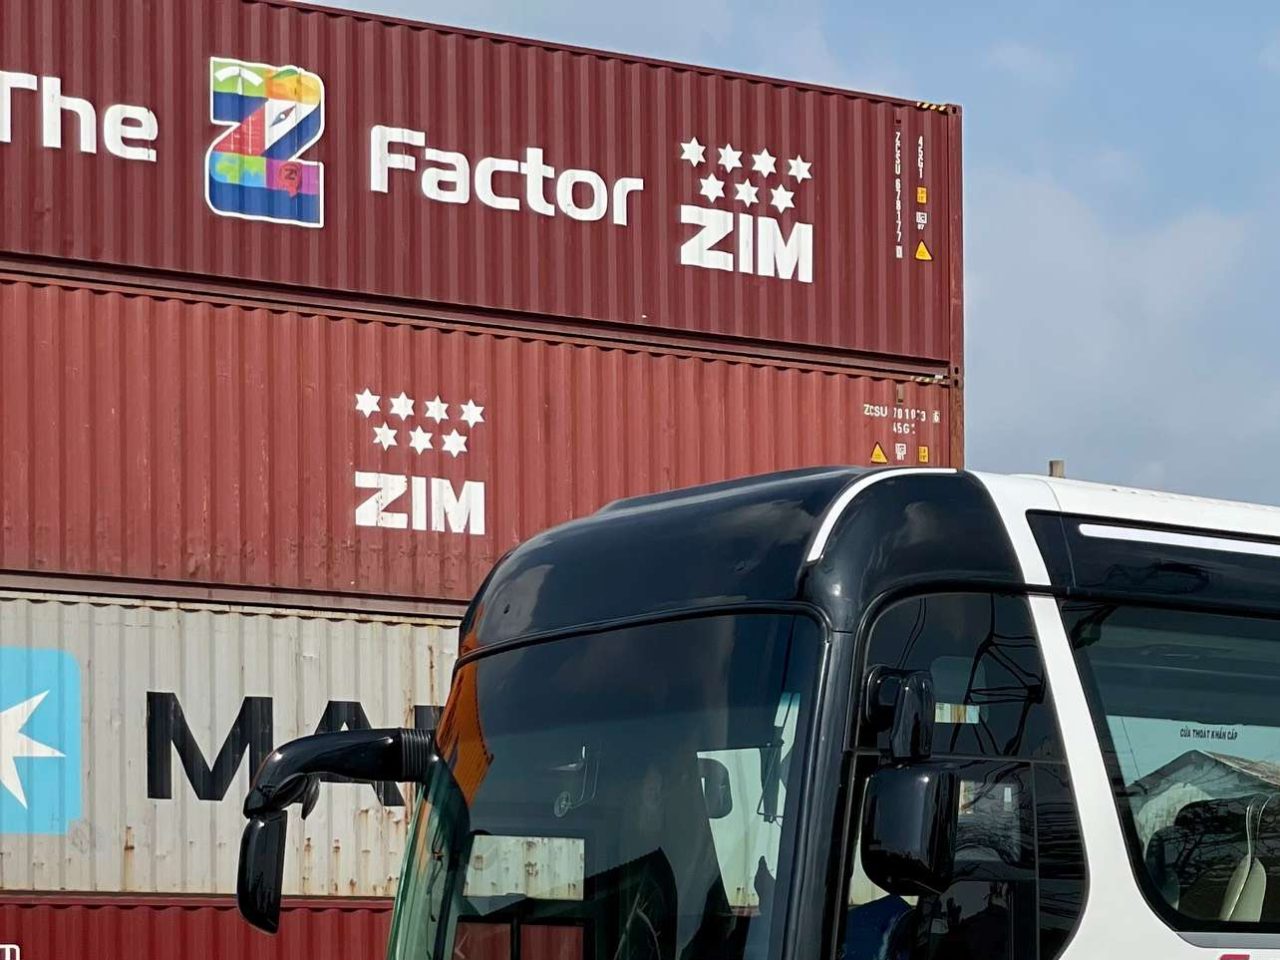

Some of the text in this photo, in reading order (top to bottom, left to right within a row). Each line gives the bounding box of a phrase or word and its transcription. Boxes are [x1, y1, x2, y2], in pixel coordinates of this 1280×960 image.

[0, 70, 158, 162] The
[370, 125, 644, 226] Factor
[680, 204, 813, 284] ZIM
[863, 403, 888, 418] ZCSU
[355, 471, 485, 535] ZIM
